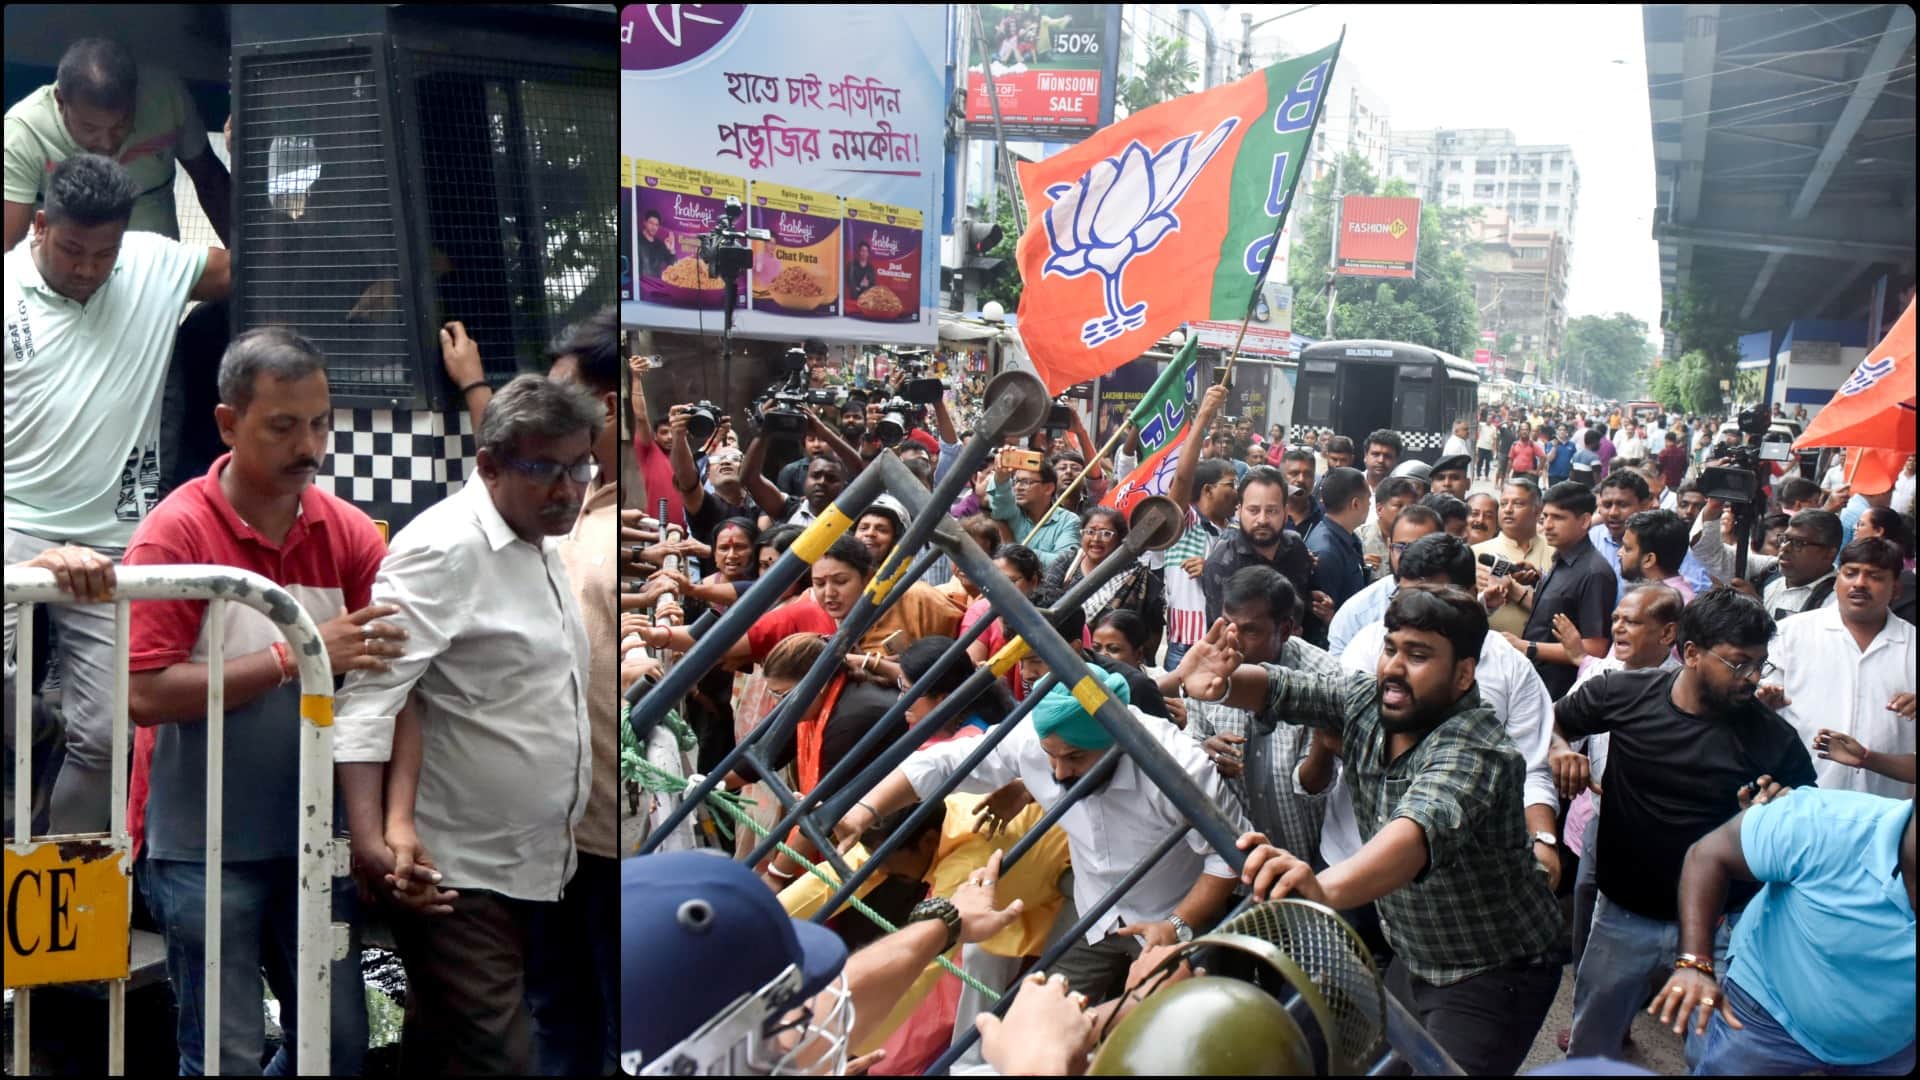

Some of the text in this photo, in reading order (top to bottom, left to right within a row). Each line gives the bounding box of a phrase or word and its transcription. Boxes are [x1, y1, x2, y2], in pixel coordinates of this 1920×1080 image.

[1057, 34, 1099, 53] 50%
[1041, 77, 1094, 92] MONSOON
[723, 72, 901, 117] হাতে চাই প্রতিদিন
[1049, 97, 1083, 112] SALE
[717, 114, 920, 169] প্রভুজির নমকীন!
[1349, 222, 1389, 233] FASHION
[776, 249, 818, 264] Chat Pata
[8, 323, 23, 362] GREAT
